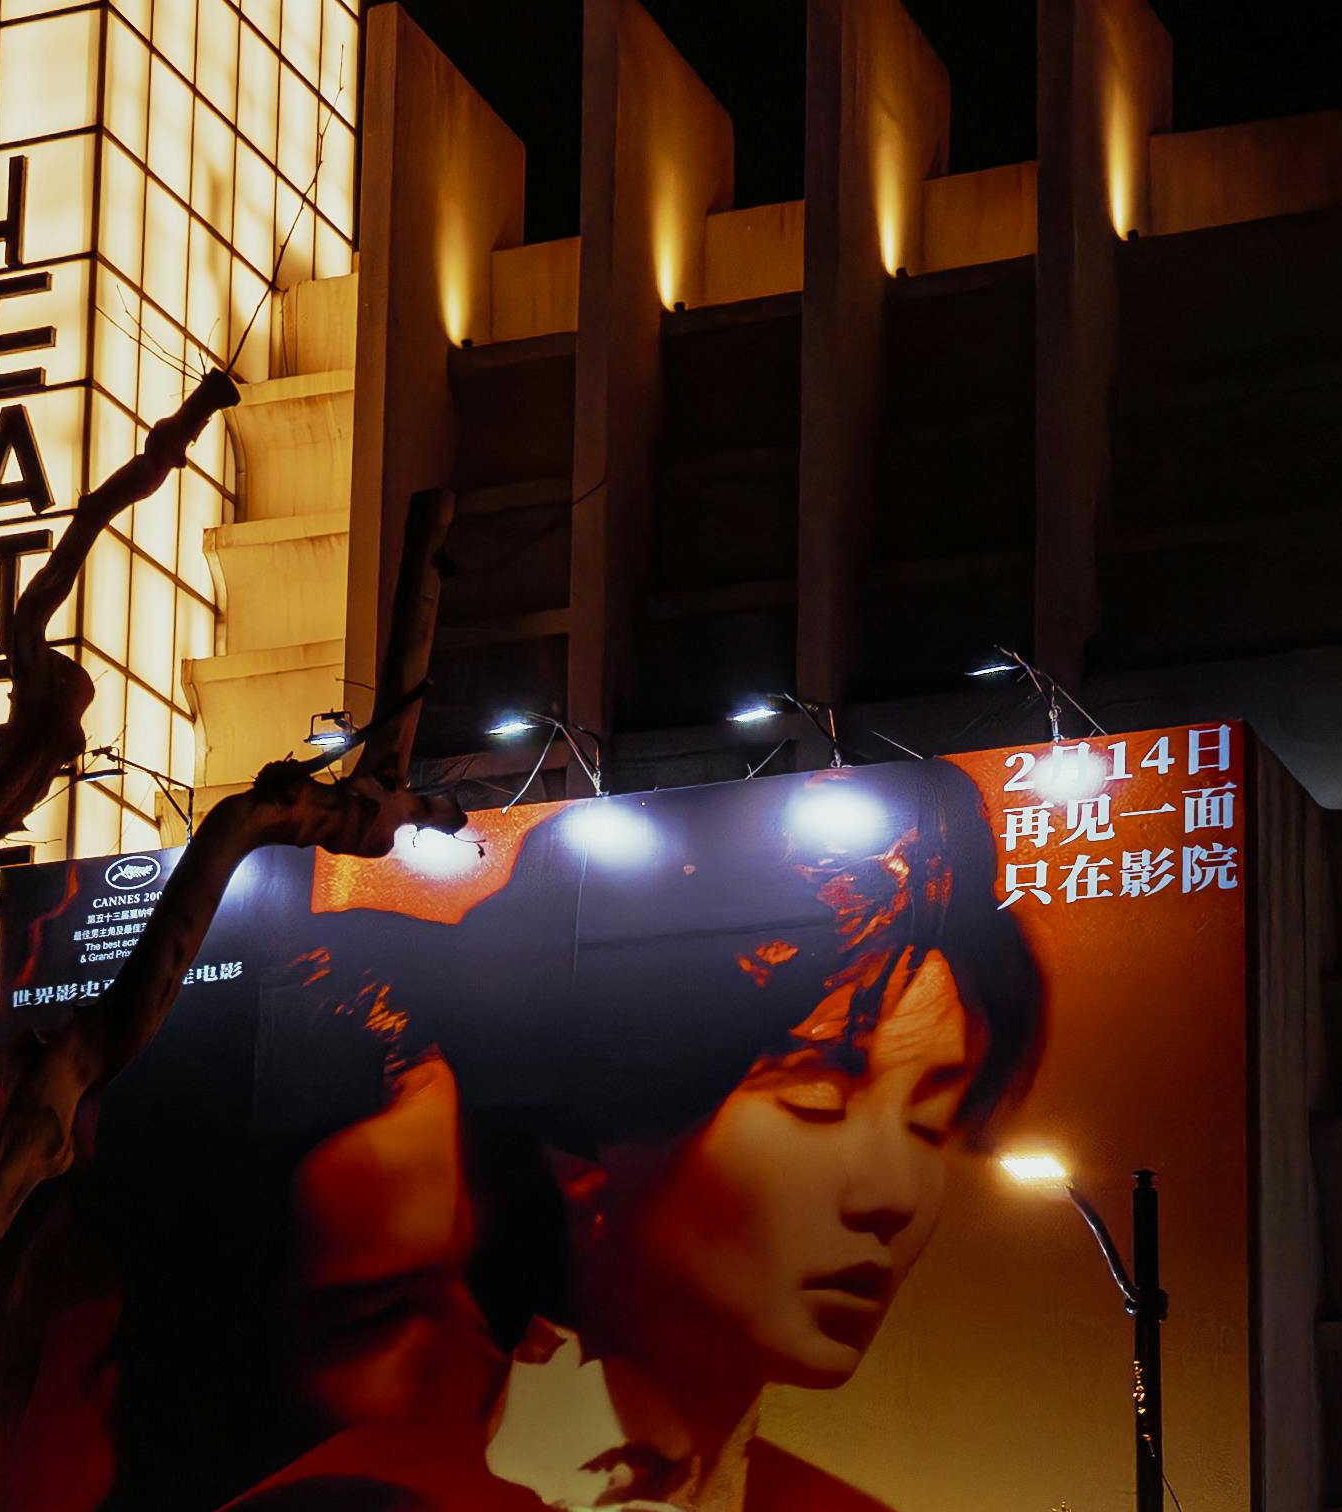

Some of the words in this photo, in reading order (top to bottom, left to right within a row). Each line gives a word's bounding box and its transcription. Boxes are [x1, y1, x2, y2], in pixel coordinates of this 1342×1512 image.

[999, 781, 1237, 852] 再见一面
[996, 842, 1239, 911] 只在影院
[92, 893, 140, 909] CANNES
[85, 941, 101, 952] The
[102, 938, 121, 950] best
[79, 953, 87, 964] &
[88, 949, 115, 963] Grand
